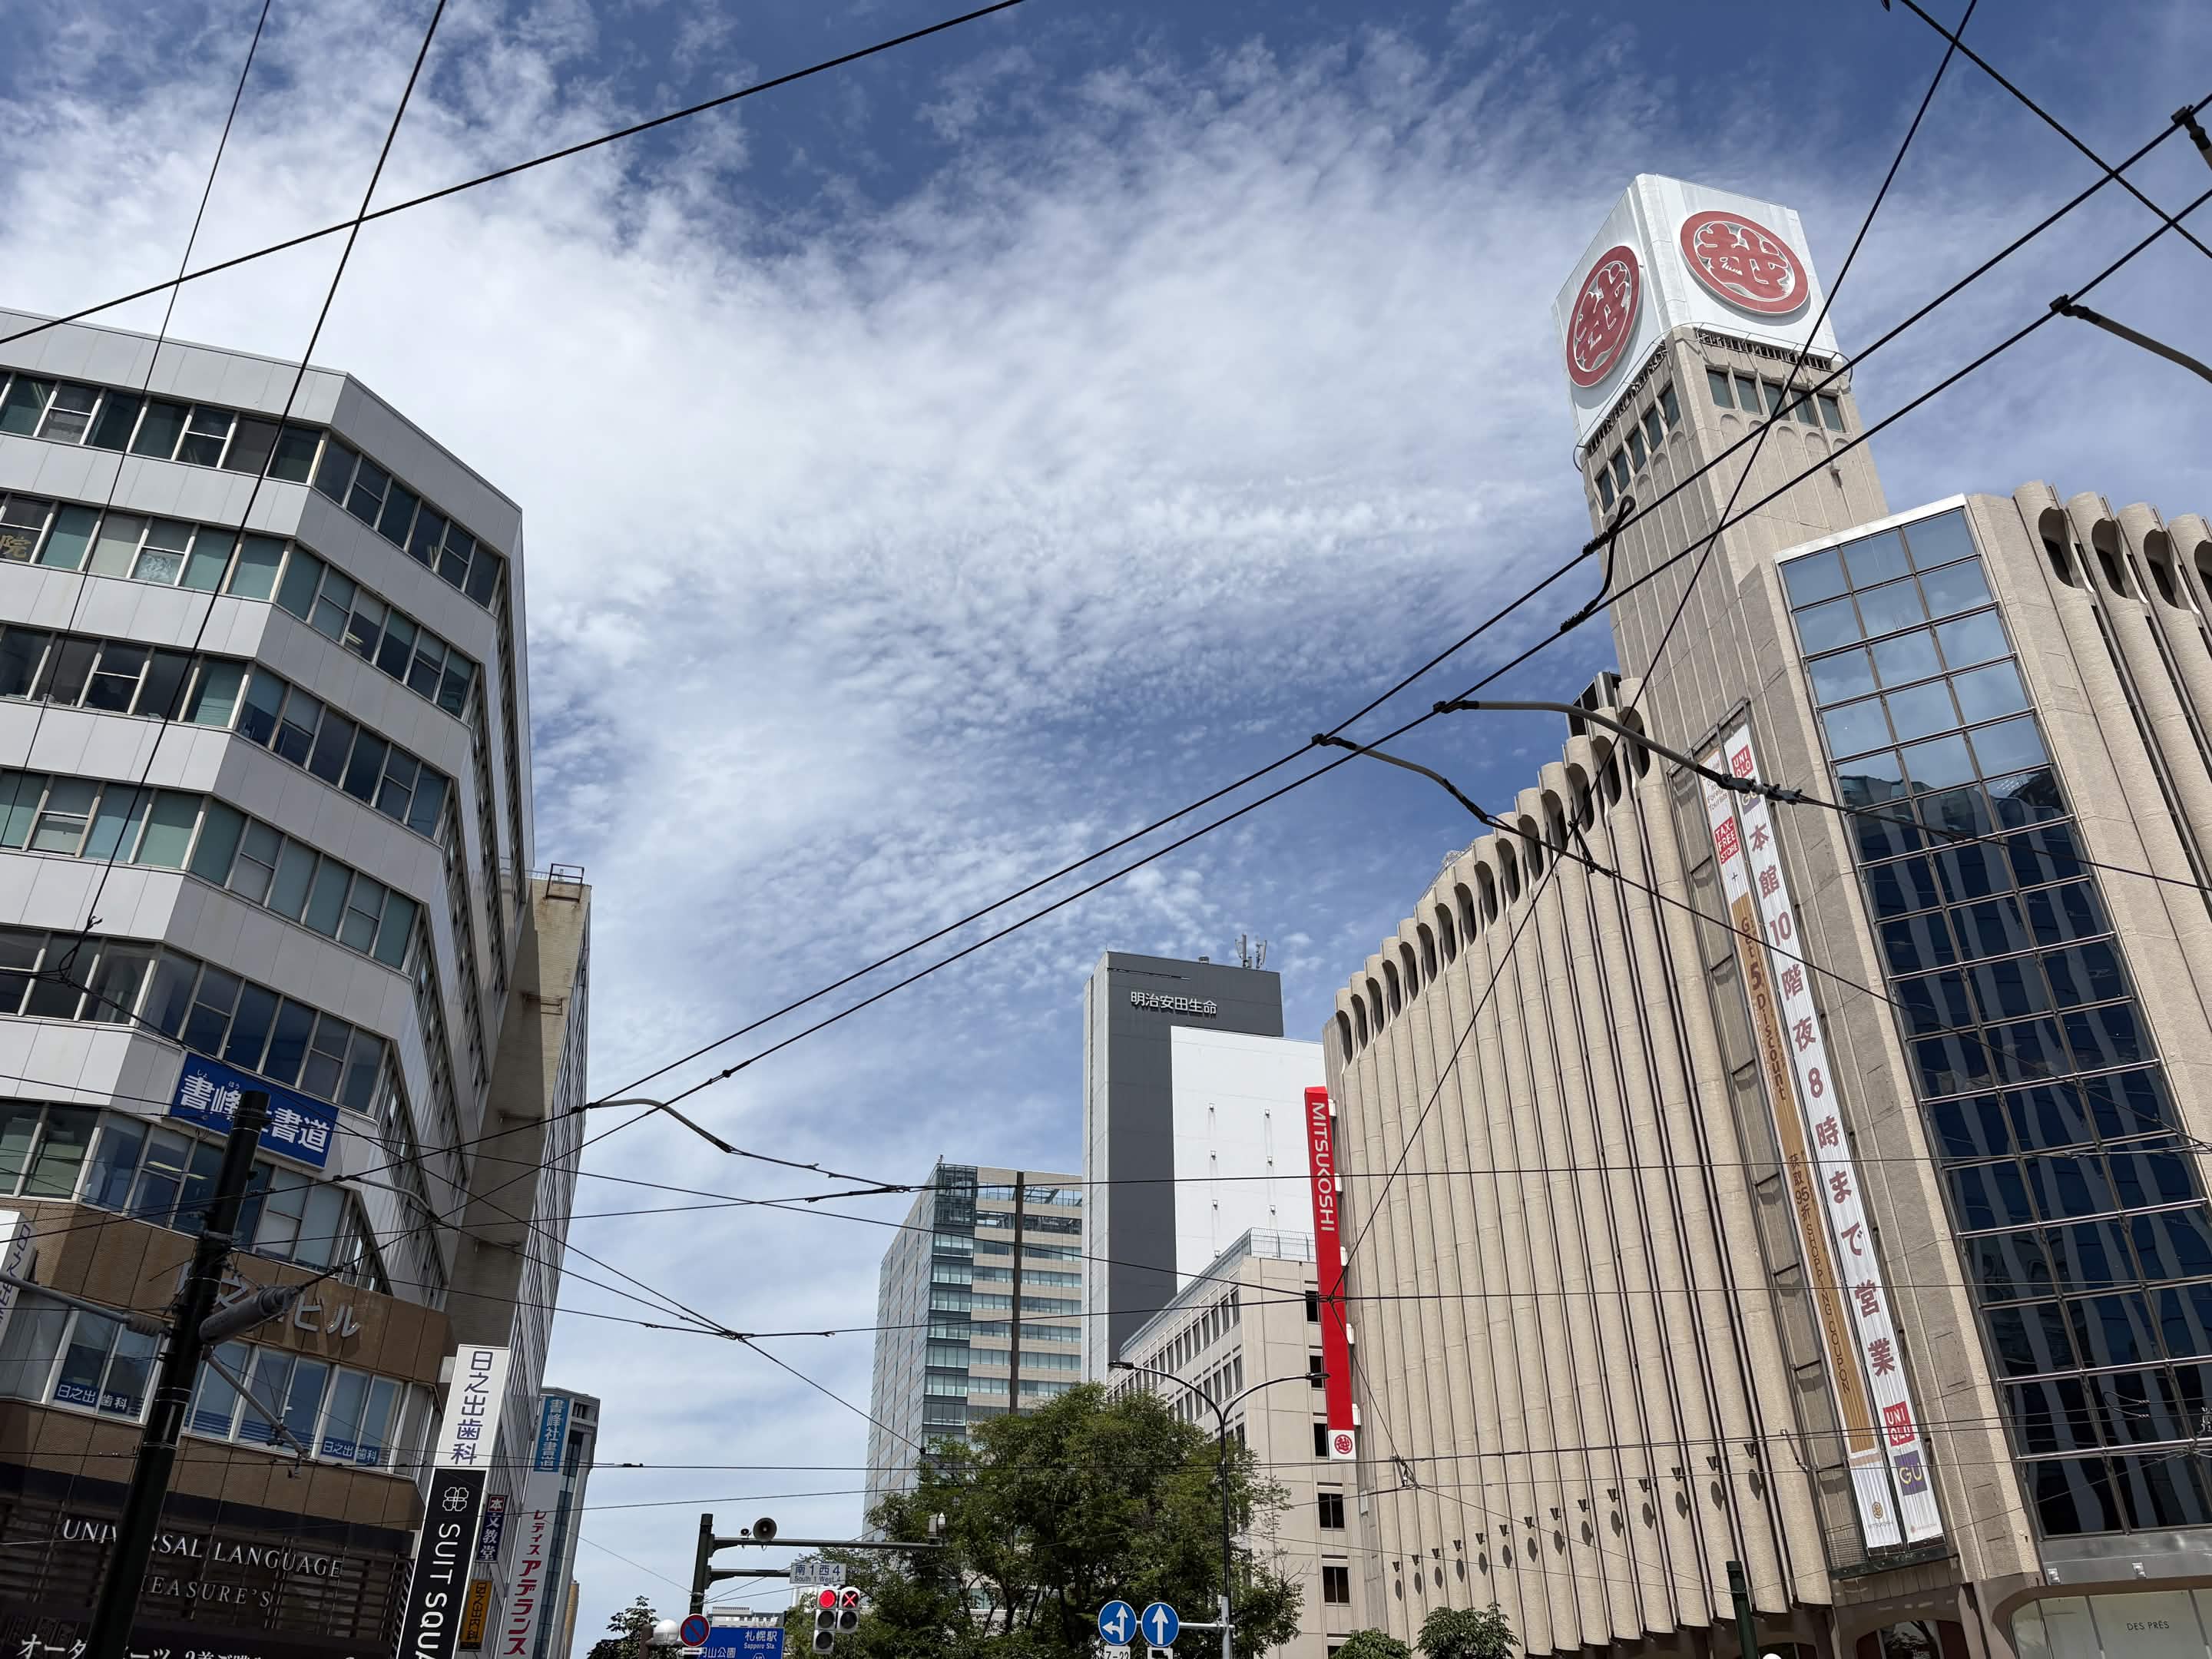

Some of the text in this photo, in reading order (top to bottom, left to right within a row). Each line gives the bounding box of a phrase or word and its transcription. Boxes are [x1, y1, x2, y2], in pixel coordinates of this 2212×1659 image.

[1718, 830, 1735, 851] FREE
[1721, 843, 1738, 862] STORE
[1131, 992, 1217, 1015] 明治安田生命
[1757, 993, 1786, 1100] Discount
[180, 1075, 330, 1153] 書峰書道
[1312, 1102, 1335, 1231] MITSUKOSHI
[1829, 1321, 1850, 1394] COUPON
[56, 1384, 128, 1410] 日之出歯科
[451, 1350, 494, 1465] 日之出歯科
[323, 1441, 377, 1462] 日之出歯科
[539, 1399, 565, 1471] 書峰社書道
[1899, 1462, 1922, 1485] GU
[63, 1518, 344, 1578] UNISAL LANGUAGE
[430, 1523, 460, 1584] SUIT
[480, 1512, 502, 1561] 文教堂
[503, 1560, 541, 1655] アデランス
[2127, 1622, 2145, 1631] DES
[744, 1630, 777, 1641] 札幌駅
